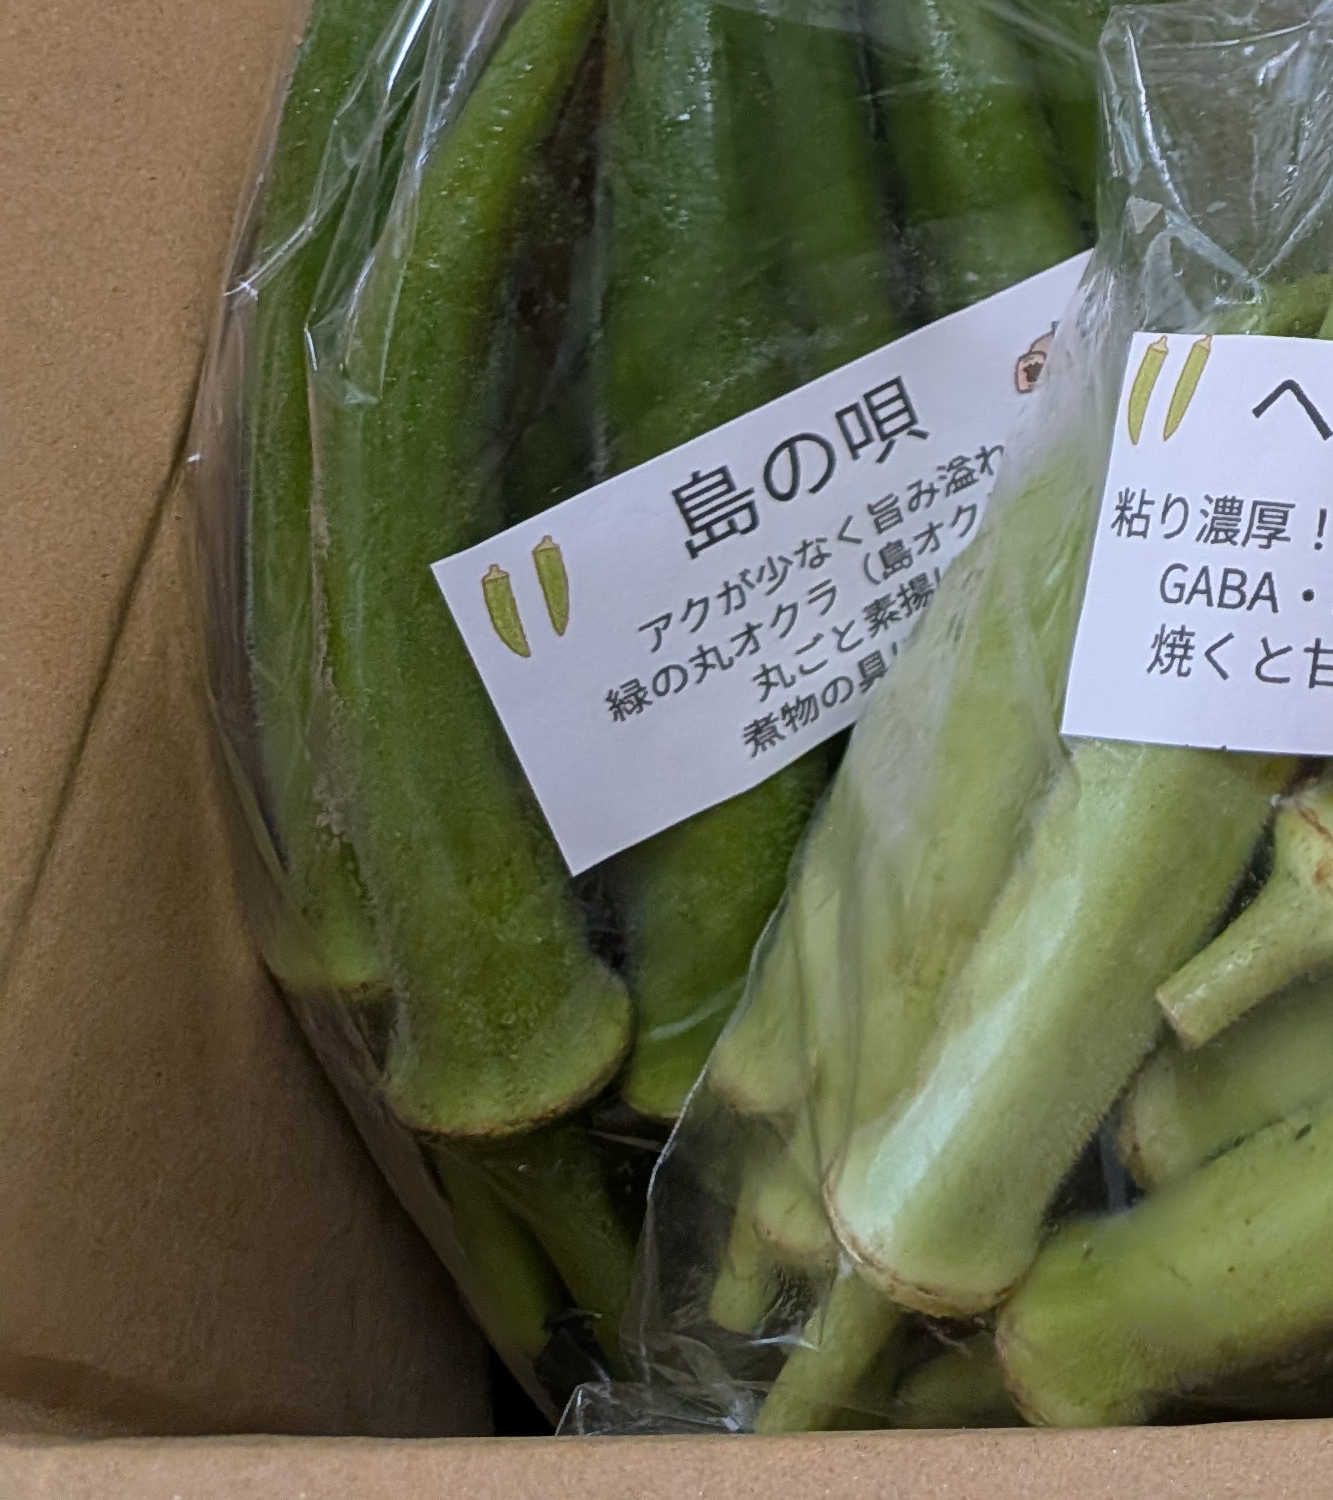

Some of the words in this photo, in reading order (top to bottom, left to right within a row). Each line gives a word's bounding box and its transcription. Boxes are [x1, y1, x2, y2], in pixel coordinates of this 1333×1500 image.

[671, 375, 929, 558] 島の唄
[742, 641, 898, 756] 煮物の具
